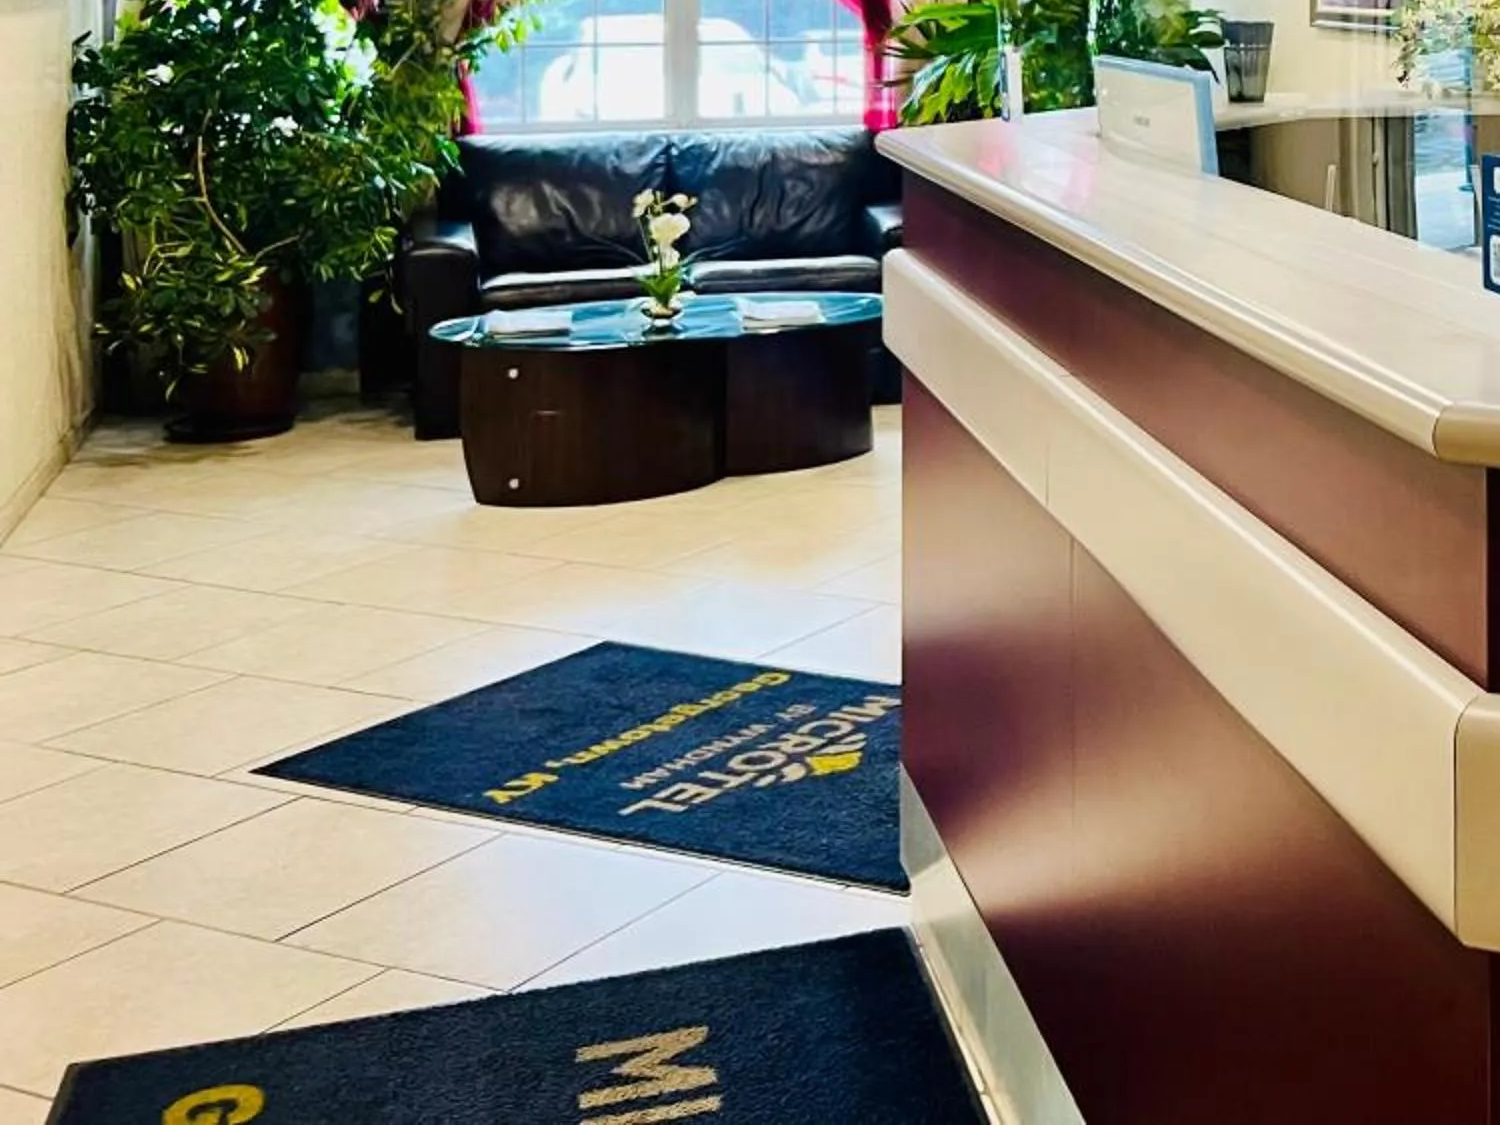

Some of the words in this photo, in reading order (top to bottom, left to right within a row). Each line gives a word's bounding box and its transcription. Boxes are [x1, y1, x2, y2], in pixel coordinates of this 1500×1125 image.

[775, 704, 816, 722] BY
[617, 696, 901, 816] MICROTEL
[619, 724, 778, 789] WYNDHAM
[483, 772, 559, 805] KY
